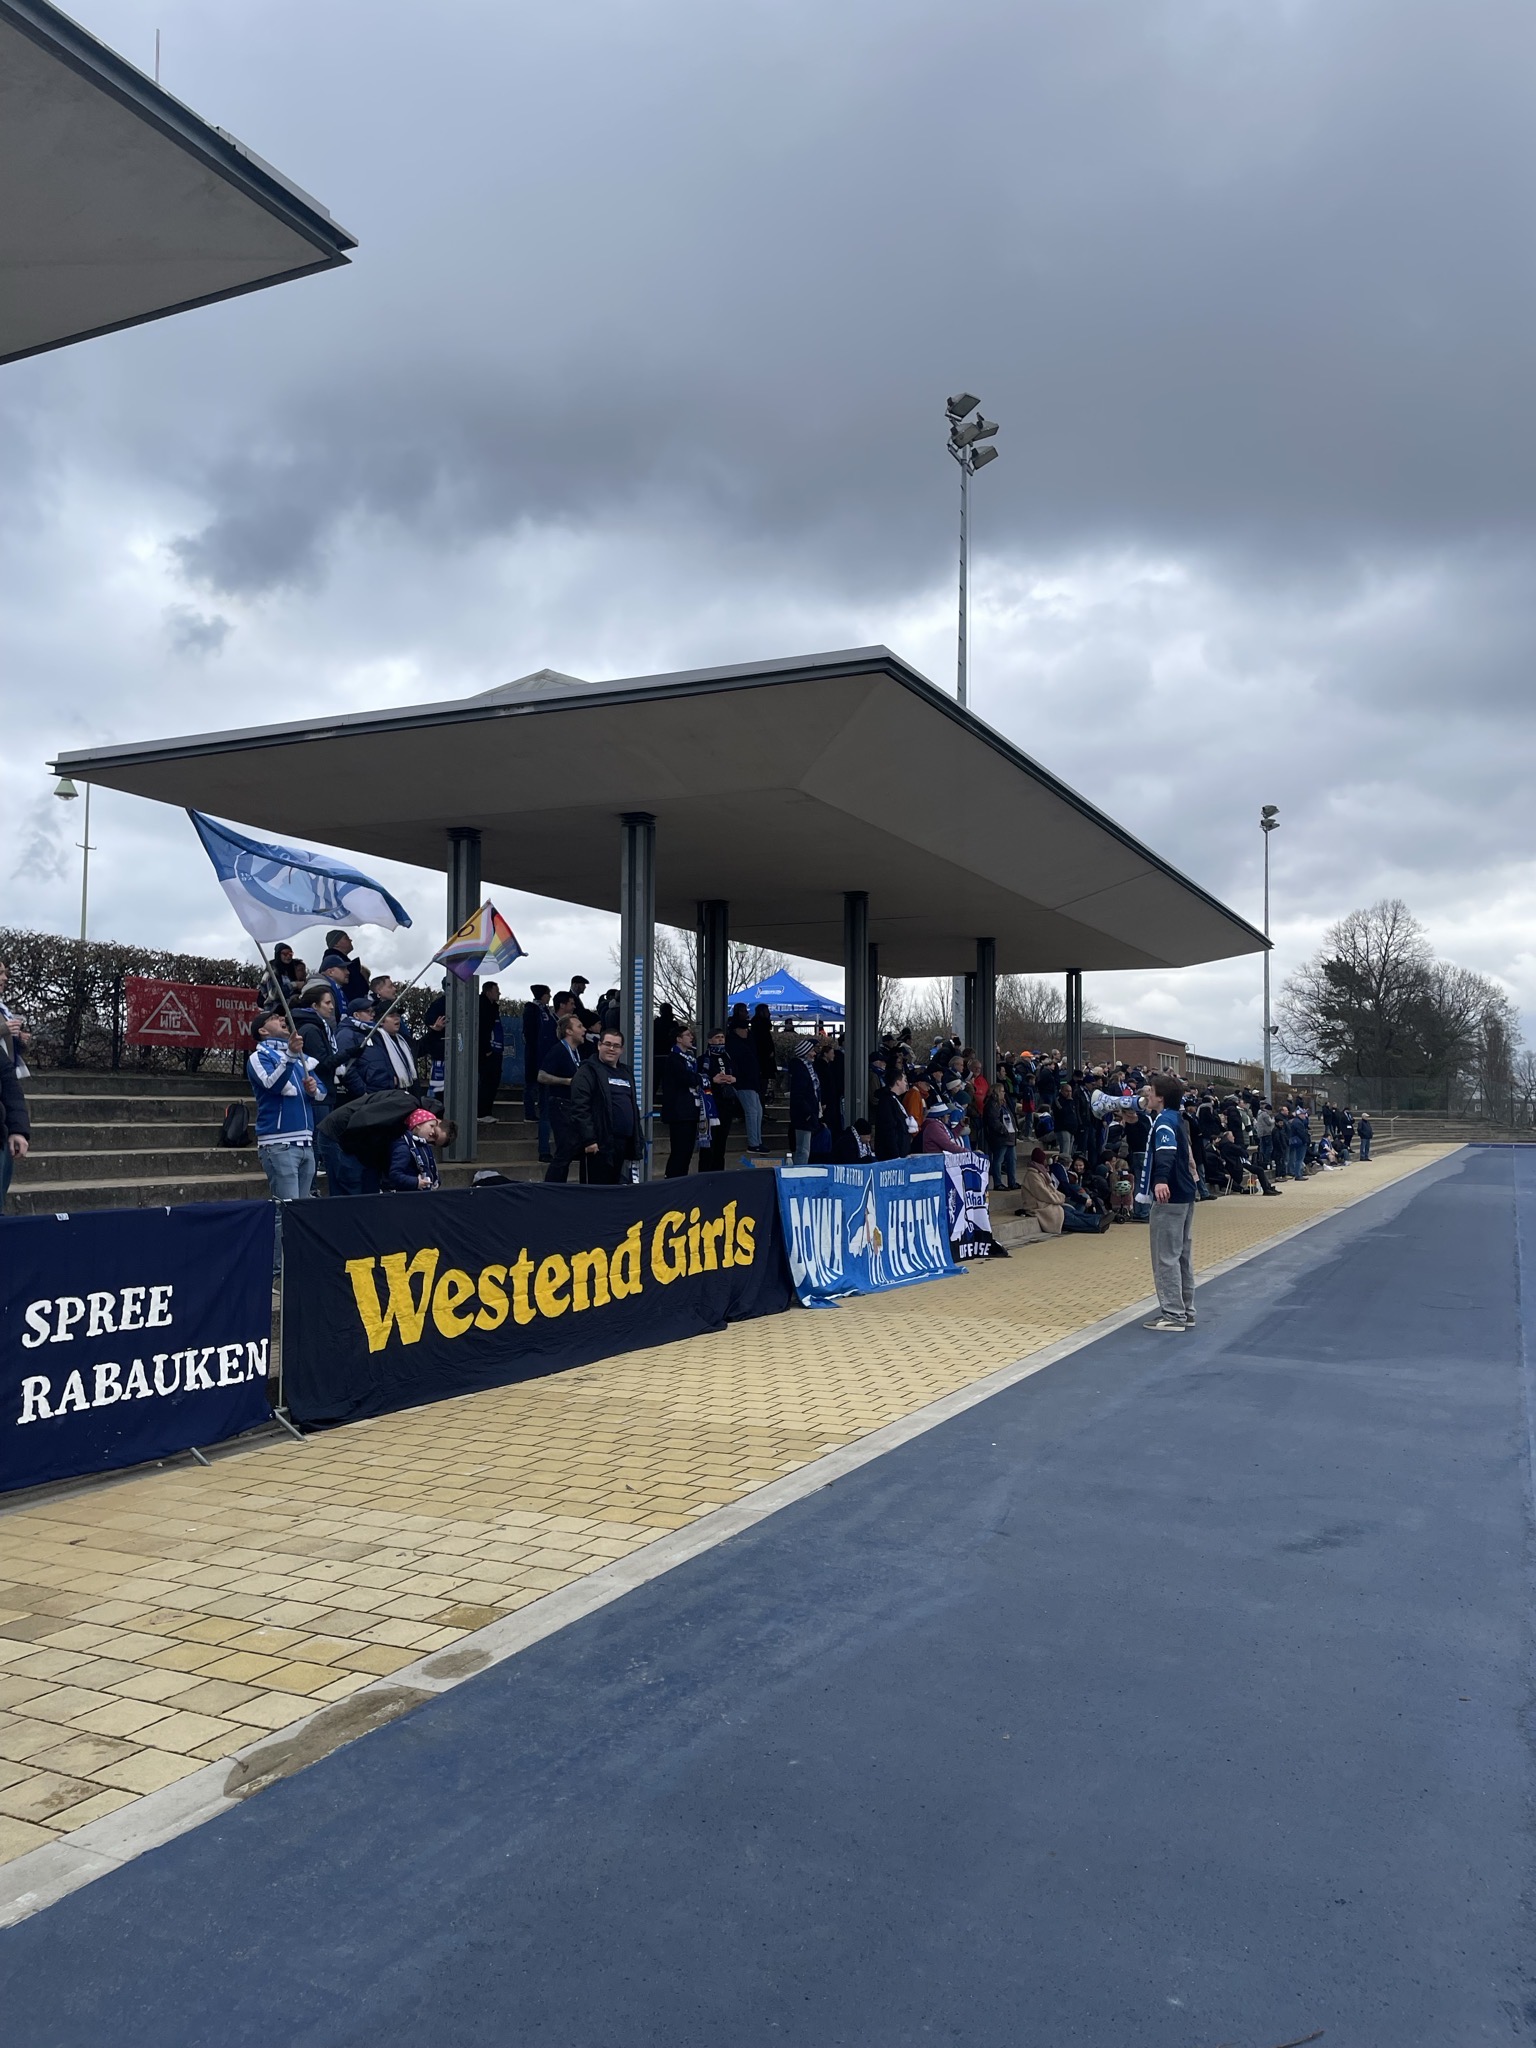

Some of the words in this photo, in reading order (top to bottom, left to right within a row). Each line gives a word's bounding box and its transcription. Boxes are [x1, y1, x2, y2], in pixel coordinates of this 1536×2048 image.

[833, 1165, 846, 1184] LOVE
[846, 1167, 864, 1187] HERTHA
[879, 1169, 898, 1188] RESPECT
[344, 1220, 644, 1354] Westend
[650, 1199, 757, 1286] Girls
[21, 1284, 174, 1349] SPREE
[16, 1338, 269, 1426] RABAUKEN
